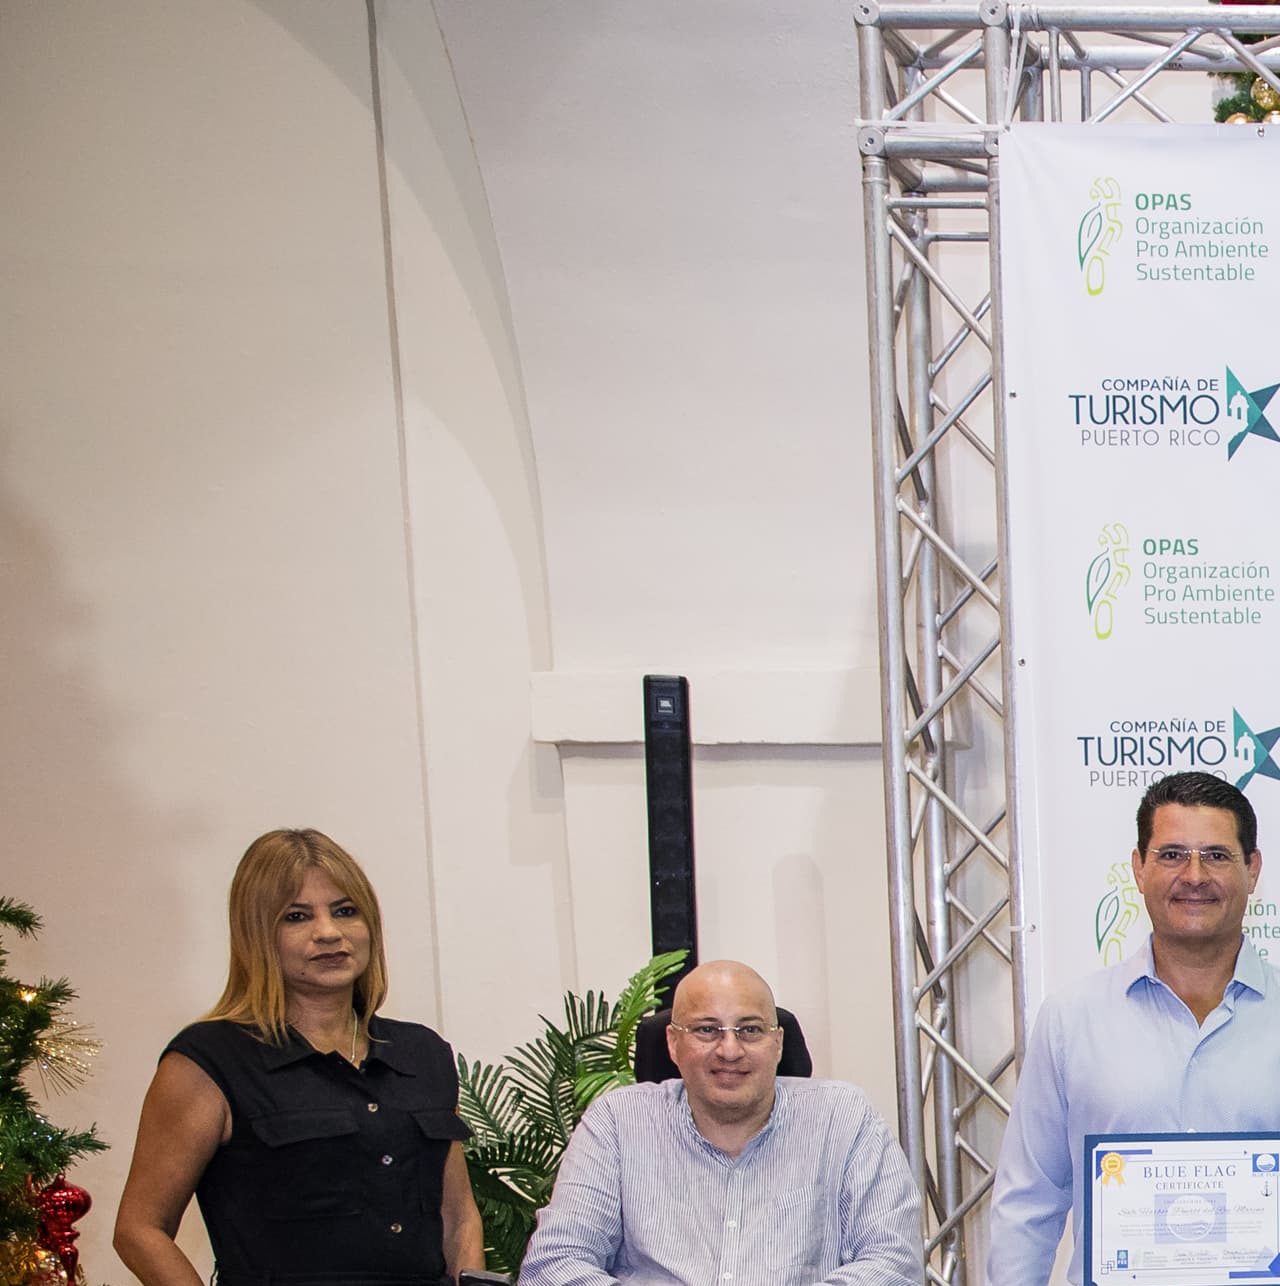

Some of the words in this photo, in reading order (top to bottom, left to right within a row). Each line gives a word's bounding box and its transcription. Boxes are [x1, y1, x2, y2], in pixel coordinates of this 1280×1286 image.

[1135, 193, 1191, 211] OPAS
[1135, 217, 1263, 240] Organización
[1136, 240, 1169, 258] Pro
[1175, 240, 1269, 258] Ambiente
[1136, 263, 1255, 281] Sustentable
[1101, 376, 1191, 391] COMPAÑÍA
[1197, 379, 1219, 391] DE
[1068, 394, 1220, 425] TURISMO
[1082, 429, 1159, 446] PUERTO
[1169, 429, 1220, 446] RICO
[1143, 538, 1199, 556] OPAS
[1143, 561, 1270, 584] Organización
[1144, 584, 1176, 602] Pro
[1182, 584, 1275, 602] Ambiente
[1144, 606, 1261, 624] Sustentable
[1110, 718, 1198, 733] COMPAÑÍA
[1204, 720, 1226, 733] DE
[1077, 736, 1227, 766] TURISMO
[1143, 1166, 1188, 1178] BLUE
[1195, 1165, 1237, 1177] FLAG
[1155, 1181, 1224, 1191] CERTIFICATE
